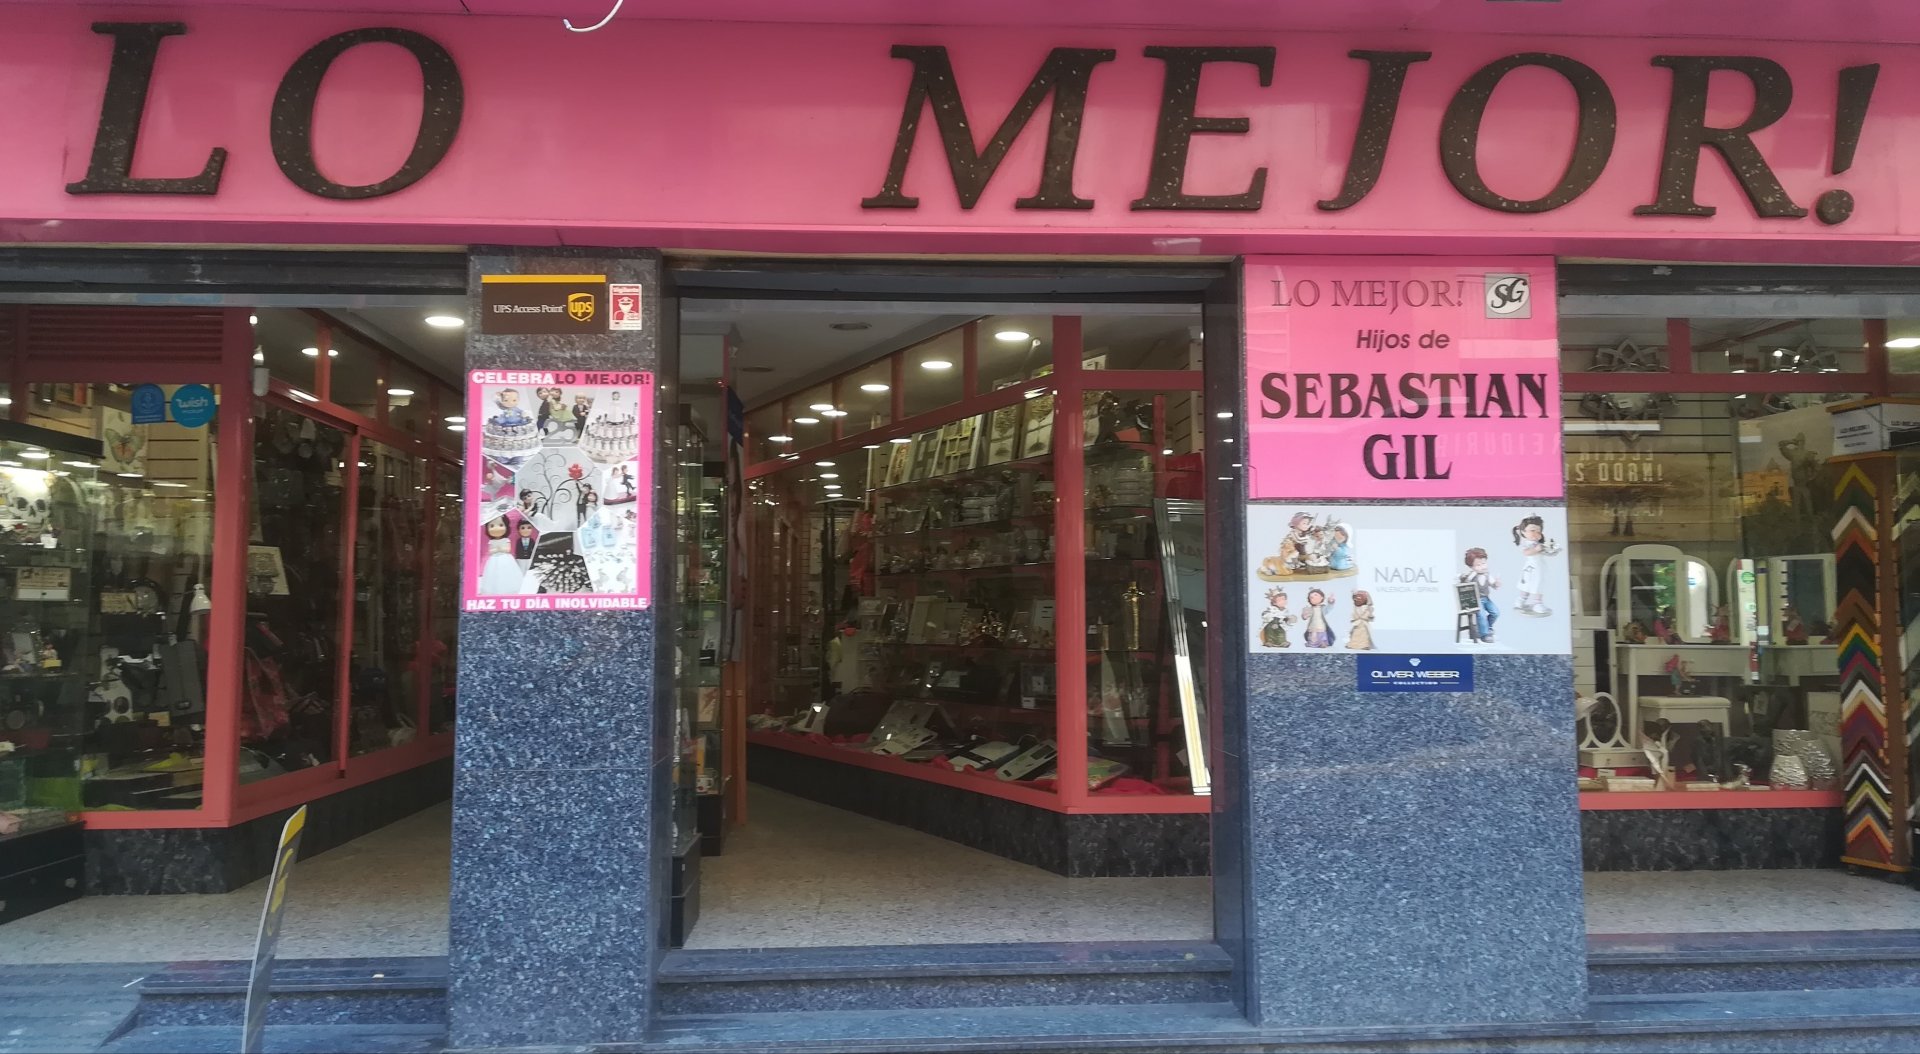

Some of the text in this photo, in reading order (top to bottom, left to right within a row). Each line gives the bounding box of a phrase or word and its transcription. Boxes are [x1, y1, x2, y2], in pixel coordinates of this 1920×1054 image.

[66, 22, 1881, 225] LO MEJOR!
[1271, 279, 1464, 315] LO MEJOR!
[493, 304, 512, 313] UPS
[513, 304, 541, 313] Access
[571, 301, 593, 317] ups
[1356, 329, 1450, 353] Hijos de
[585, 373, 650, 385] MEJOR!
[1260, 372, 1549, 419] SEBASTIAN
[1363, 434, 1453, 480] GIL
[1374, 566, 1440, 583] NADAL
[466, 596, 648, 611] HAZ TU DÍA INOLVIDABLE
[1371, 670, 1460, 678] OLIVER WEBER
